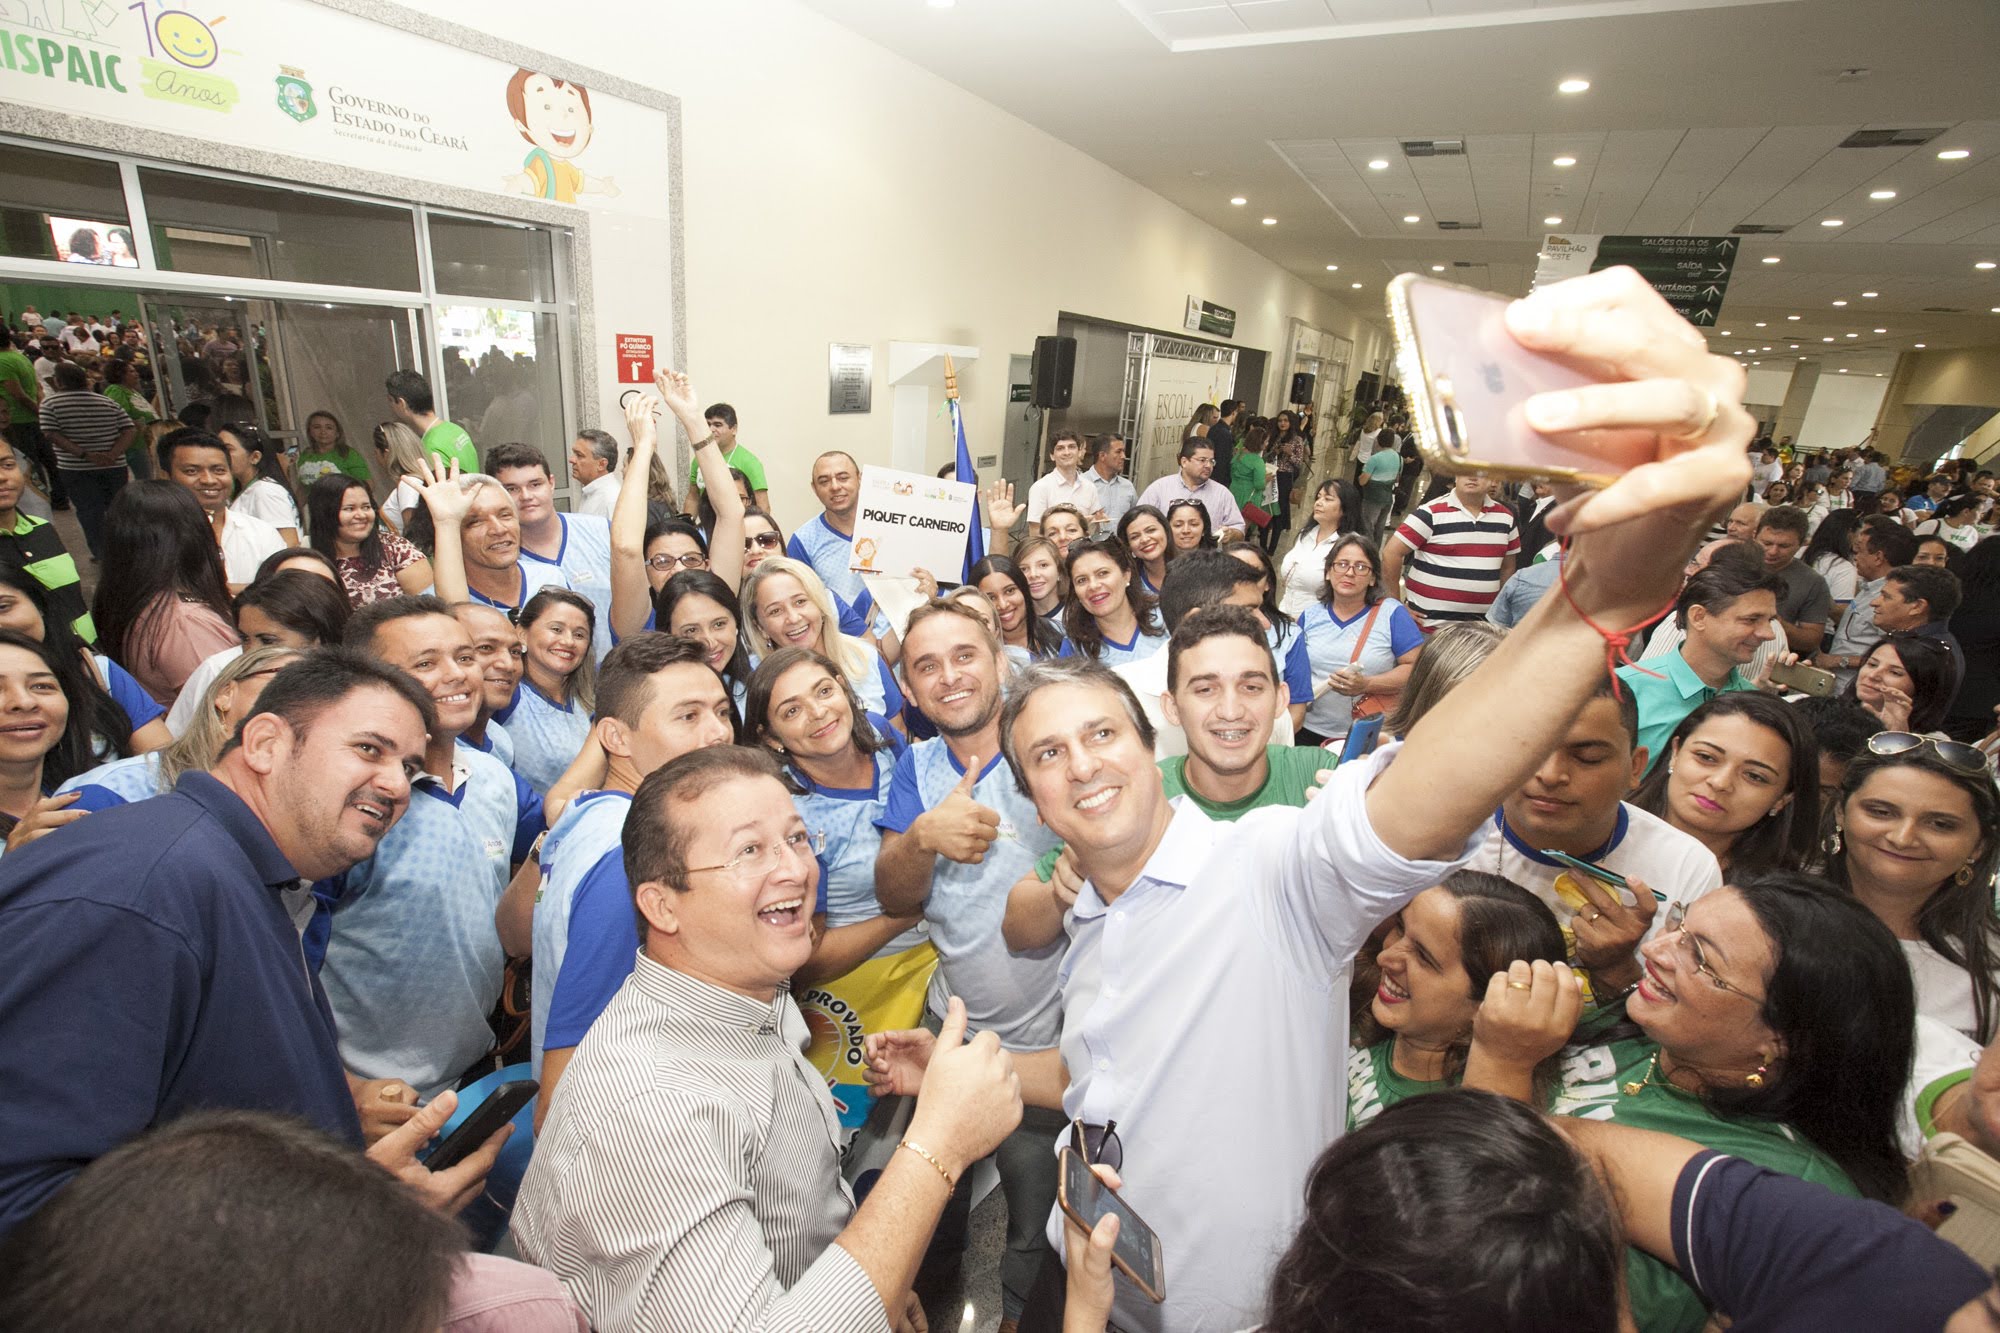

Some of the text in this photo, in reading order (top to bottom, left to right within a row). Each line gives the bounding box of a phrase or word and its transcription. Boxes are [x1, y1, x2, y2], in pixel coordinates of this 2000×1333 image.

[0, 29, 128, 94] ISPAIC
[332, 105, 396, 135] ESTADO
[419, 126, 469, 151] CEARÁ
[862, 508, 966, 533] PIQUET CARNEIRO
[805, 989, 865, 1066] PROVADO
